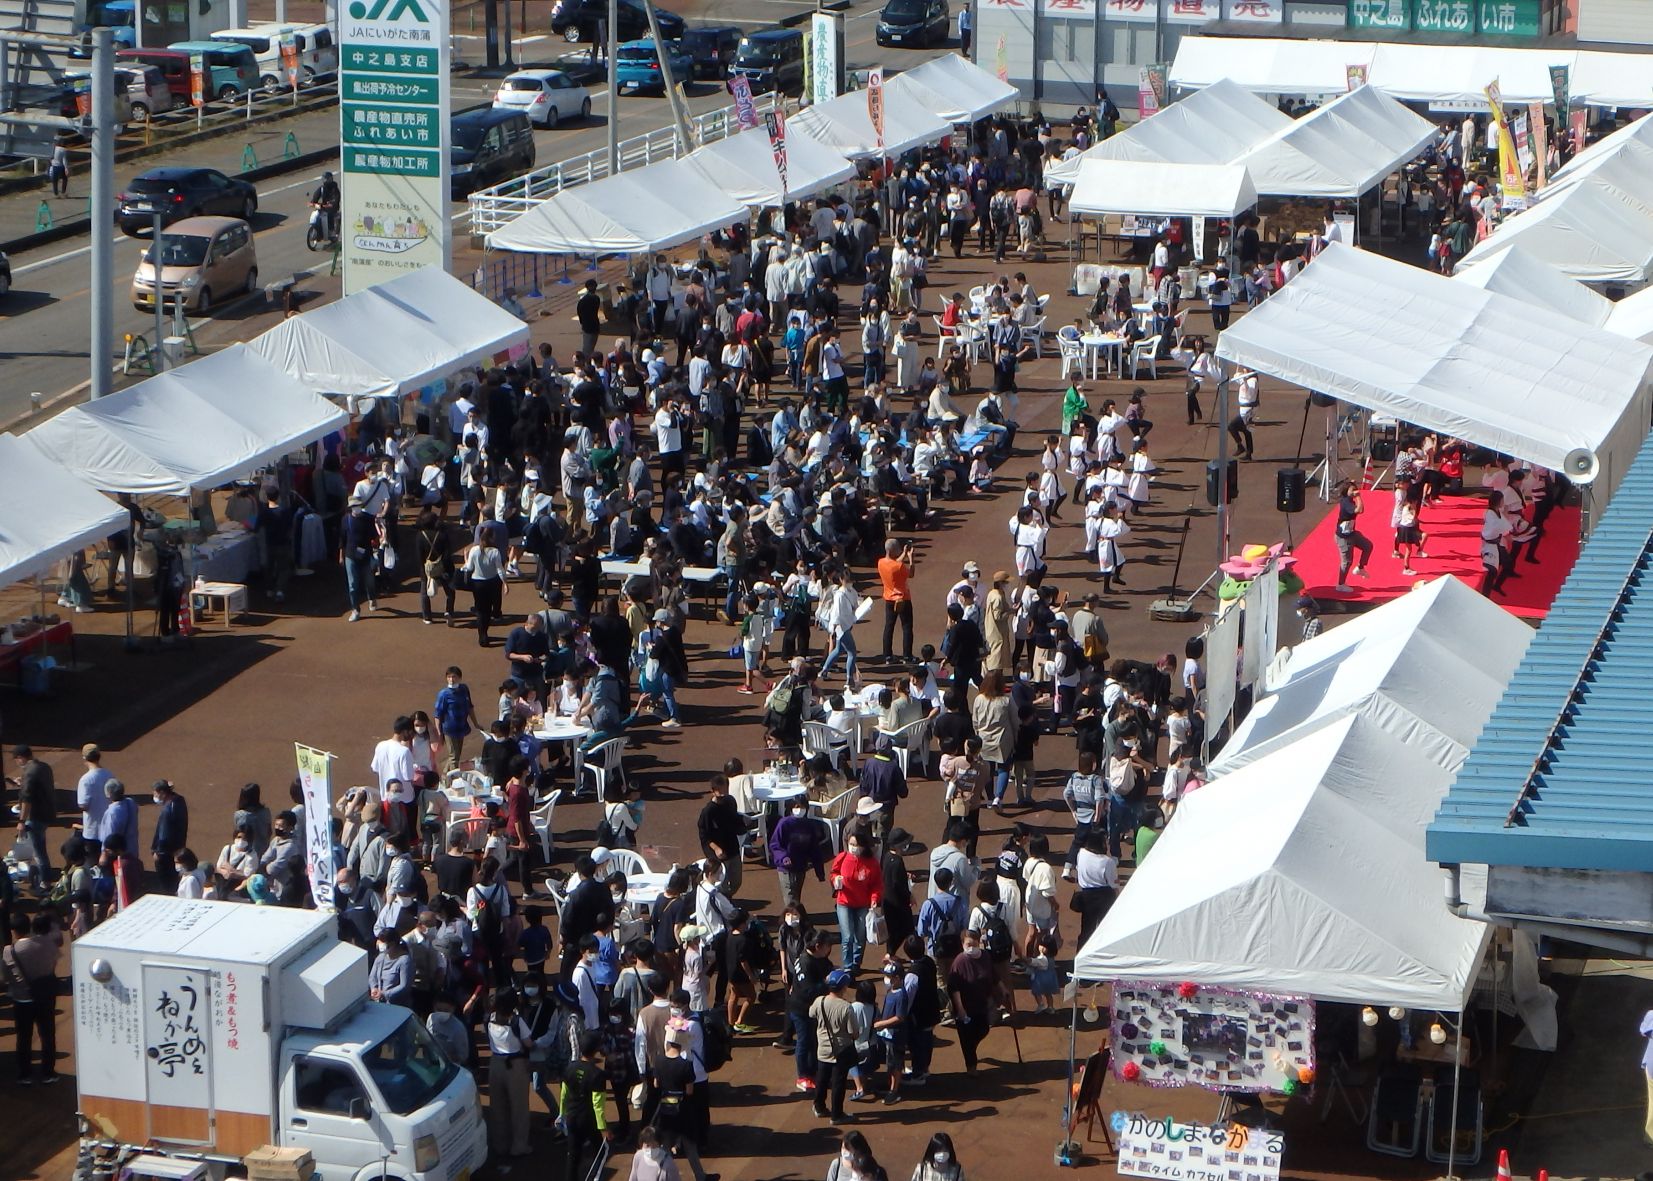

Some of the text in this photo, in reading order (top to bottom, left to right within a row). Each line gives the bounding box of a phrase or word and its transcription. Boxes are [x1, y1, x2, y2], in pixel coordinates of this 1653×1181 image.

[352, 51, 428, 68] 中之島支店
[353, 81, 428, 96] 集出荷予冷センター
[353, 110, 429, 126] 農産物直売所
[353, 126, 429, 141] ふれあい市
[354, 154, 429, 170] 農産物加工所
